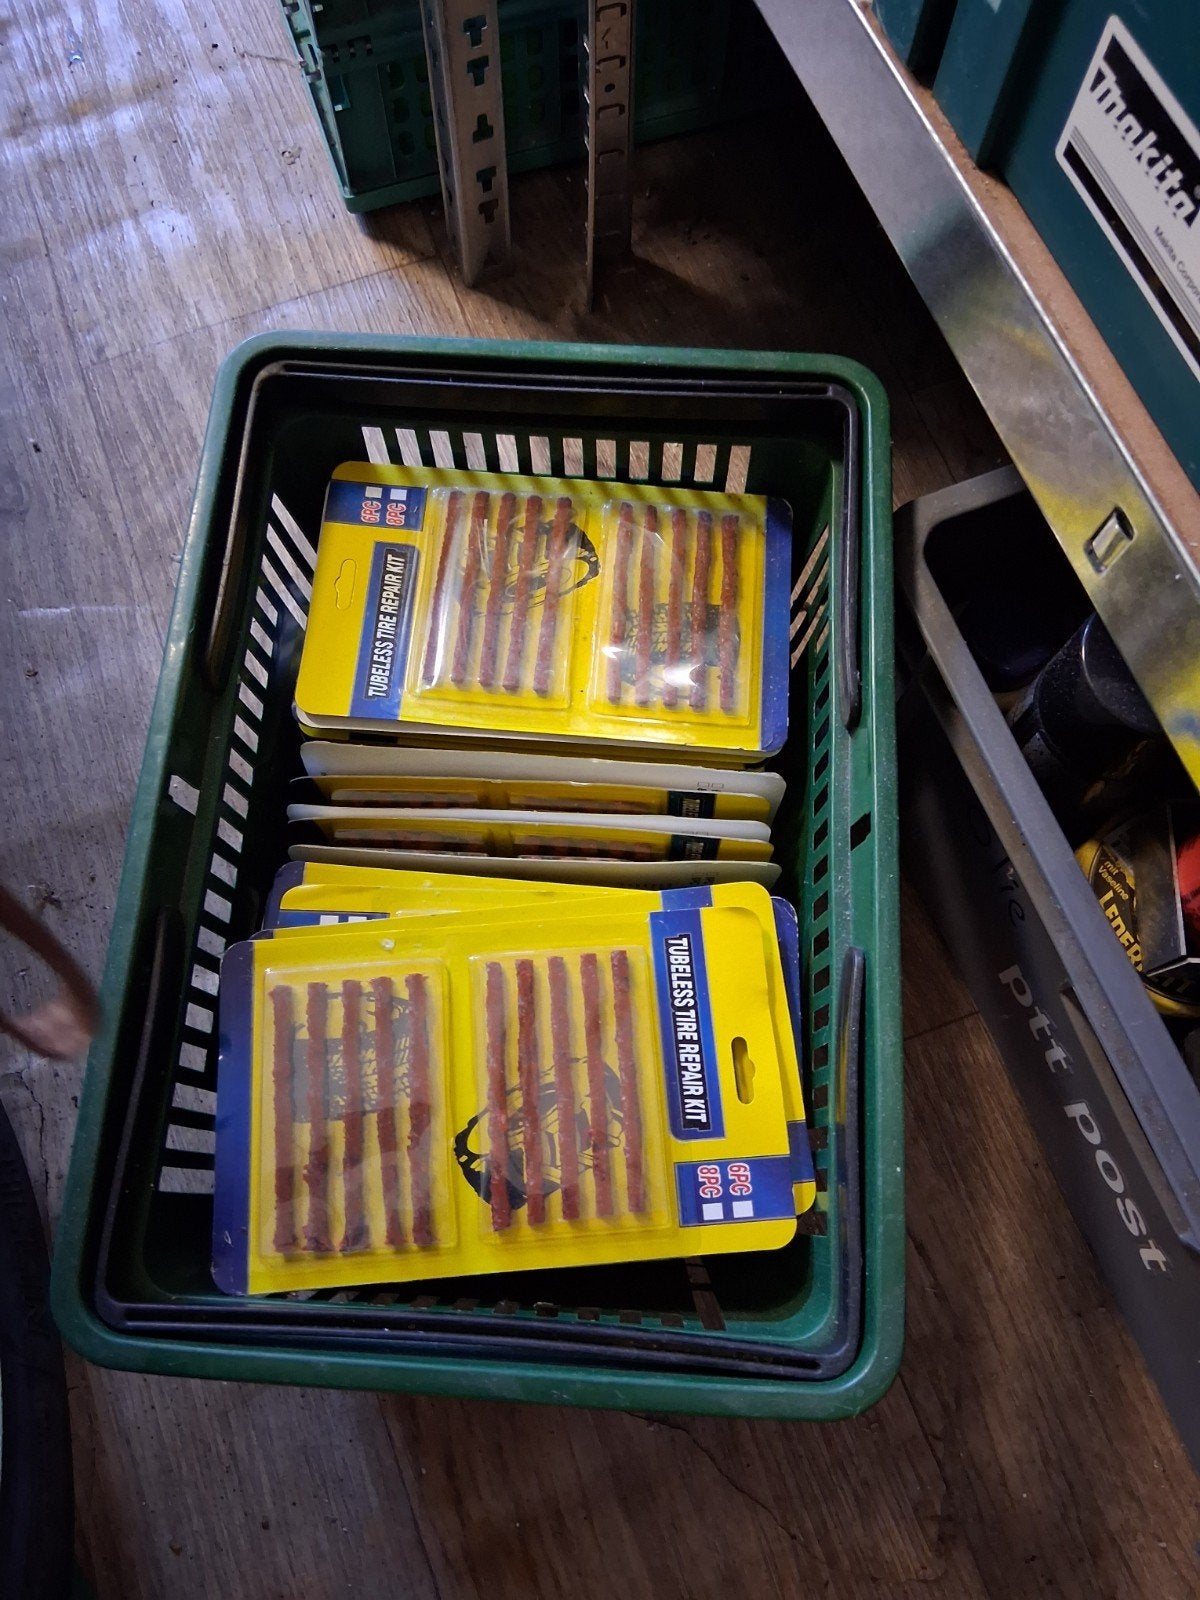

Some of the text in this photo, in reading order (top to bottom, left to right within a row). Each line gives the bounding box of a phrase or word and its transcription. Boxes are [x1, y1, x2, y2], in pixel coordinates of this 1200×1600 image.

[361, 500, 382, 524] 6PC
[386, 502, 407, 526] 8PC
[368, 554, 405, 697] TUBELESS TIRE REPAIR KIT
[1099, 865, 1129, 900] Vaseline
[1104, 861, 1119, 875] mit
[668, 937, 707, 1123] TUBELESS TIRE REPAIR KIT
[999, 963, 1168, 1272] ptt post
[697, 1164, 722, 1198] 8PC
[727, 1162, 752, 1196] 6PC
